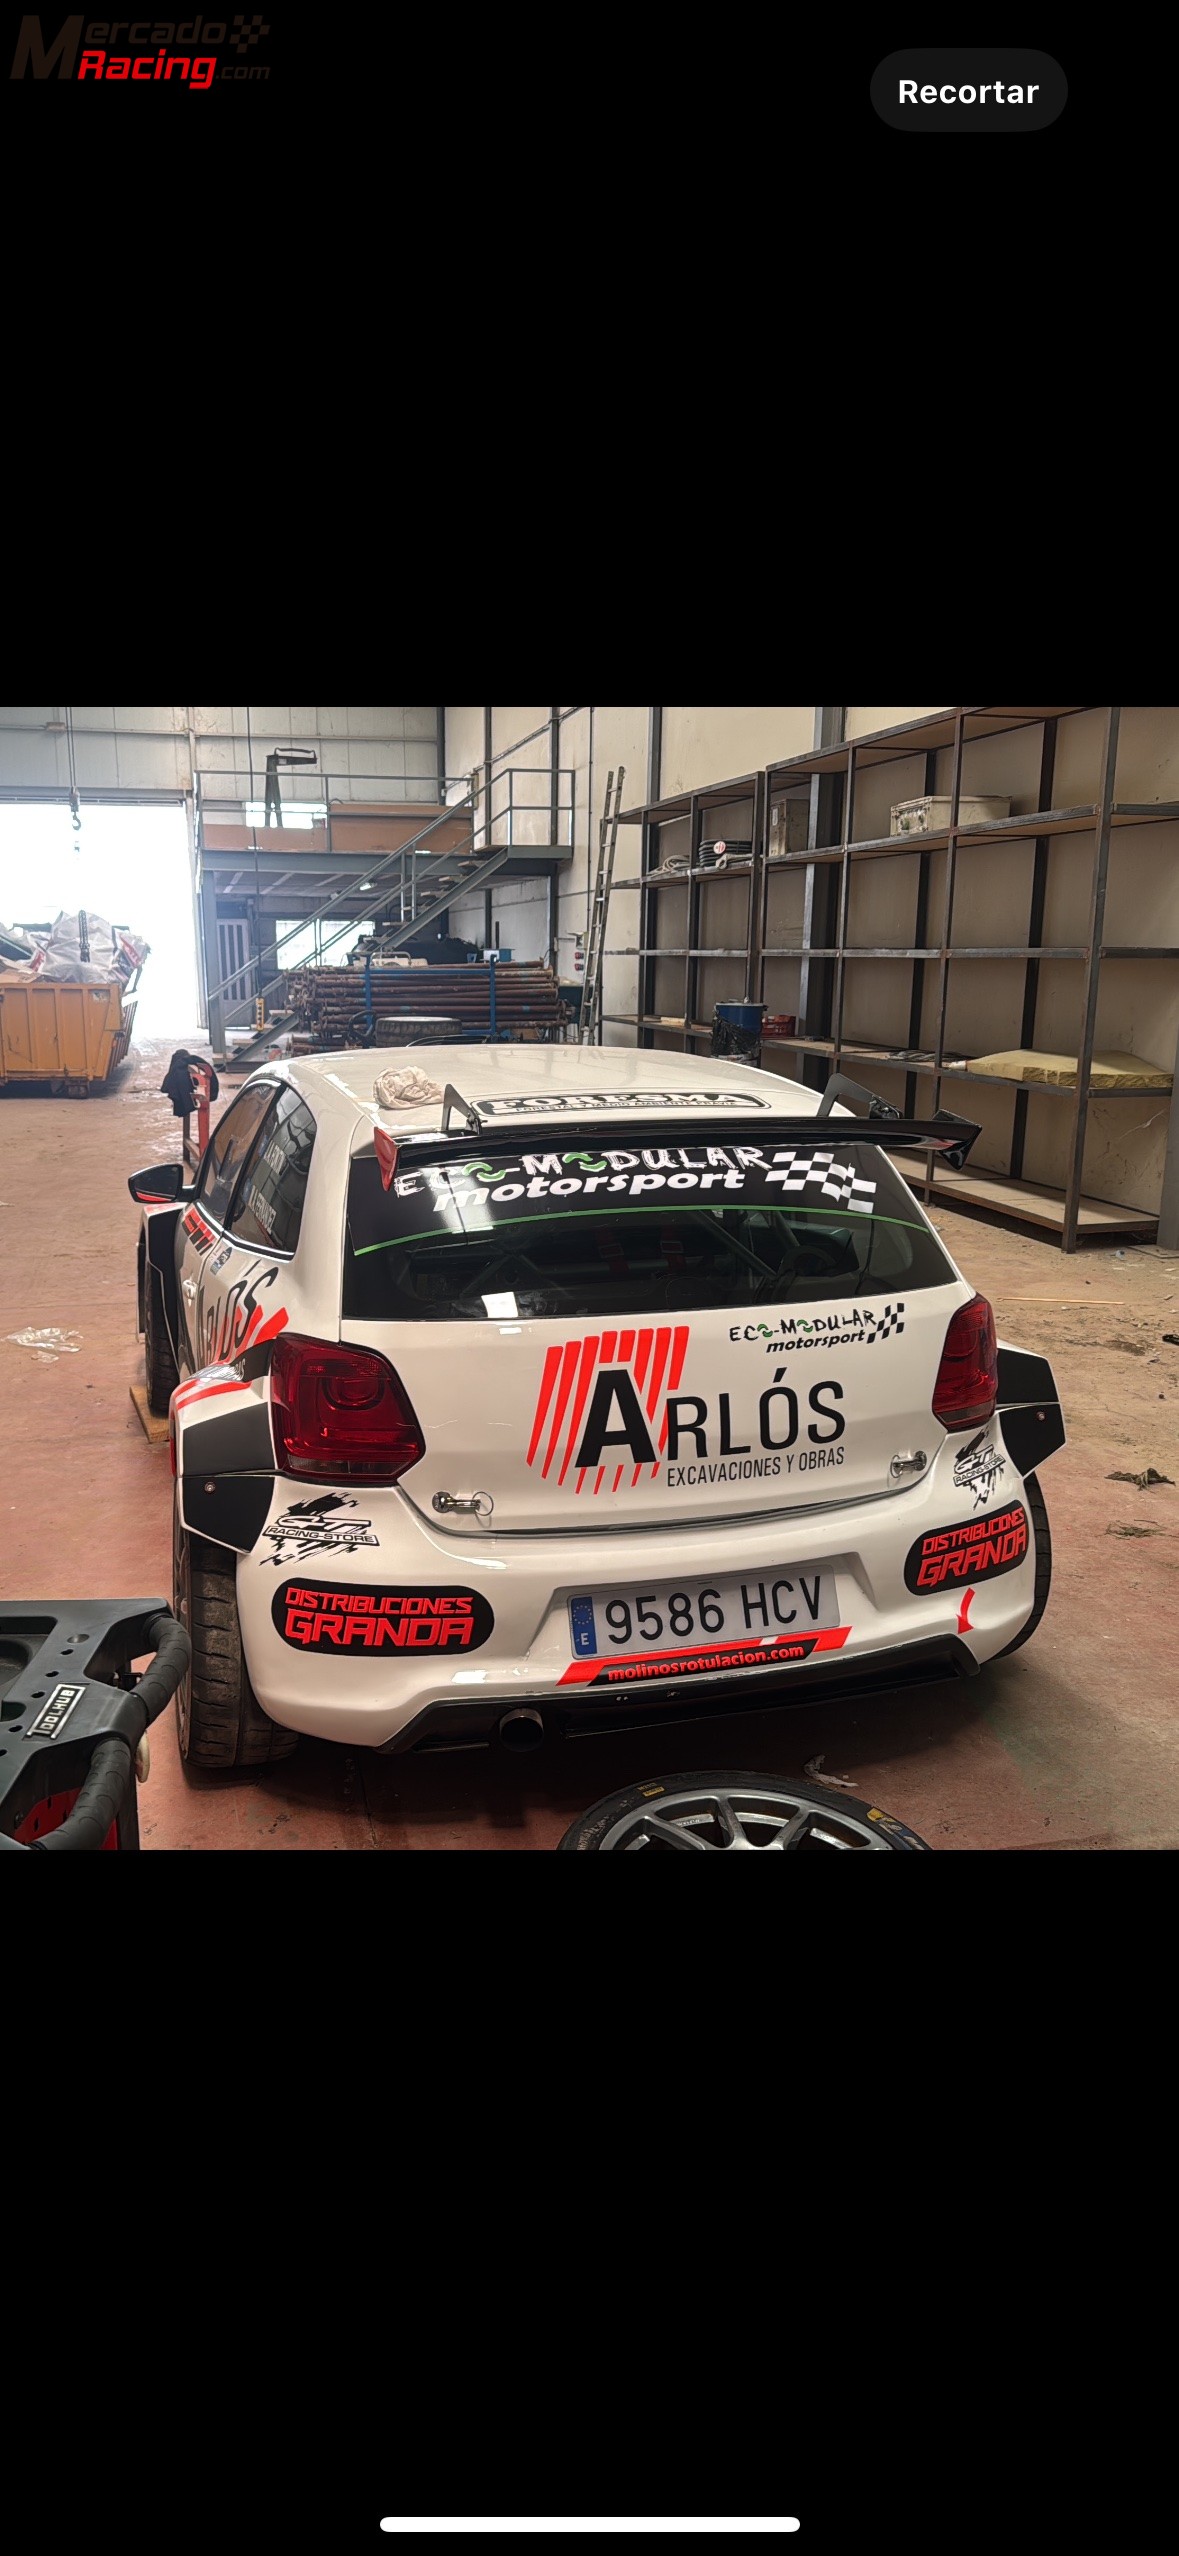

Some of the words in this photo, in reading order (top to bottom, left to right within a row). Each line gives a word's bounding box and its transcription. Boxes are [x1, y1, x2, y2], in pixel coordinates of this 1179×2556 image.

[487, 1094, 754, 1114] FORESMA
[433, 1170, 746, 1212] motorsport
[729, 1308, 878, 1342] ECO-MODULAR
[765, 1329, 866, 1354] motorsport
[575, 1366, 846, 1468] ARLÓS
[667, 1456, 781, 1487] EXCAVACIONES
[786, 1453, 795, 1473] Y
[799, 1446, 845, 1471] OBRAS
[955, 1455, 1004, 1485] RACING-STORE
[266, 1526, 376, 1543] RACING-STORE
[921, 1506, 1025, 1556] DISTRIBUCIONES
[916, 1523, 1027, 1587] GRANDA
[284, 1587, 474, 1615] DISTRIBUCIONES
[605, 1588, 725, 1645] 9586
[740, 1575, 822, 1630] HCV
[284, 1607, 475, 1647] GRANDA
[580, 1632, 590, 1646] E
[607, 1644, 805, 1681] molinosrotulacion.com
